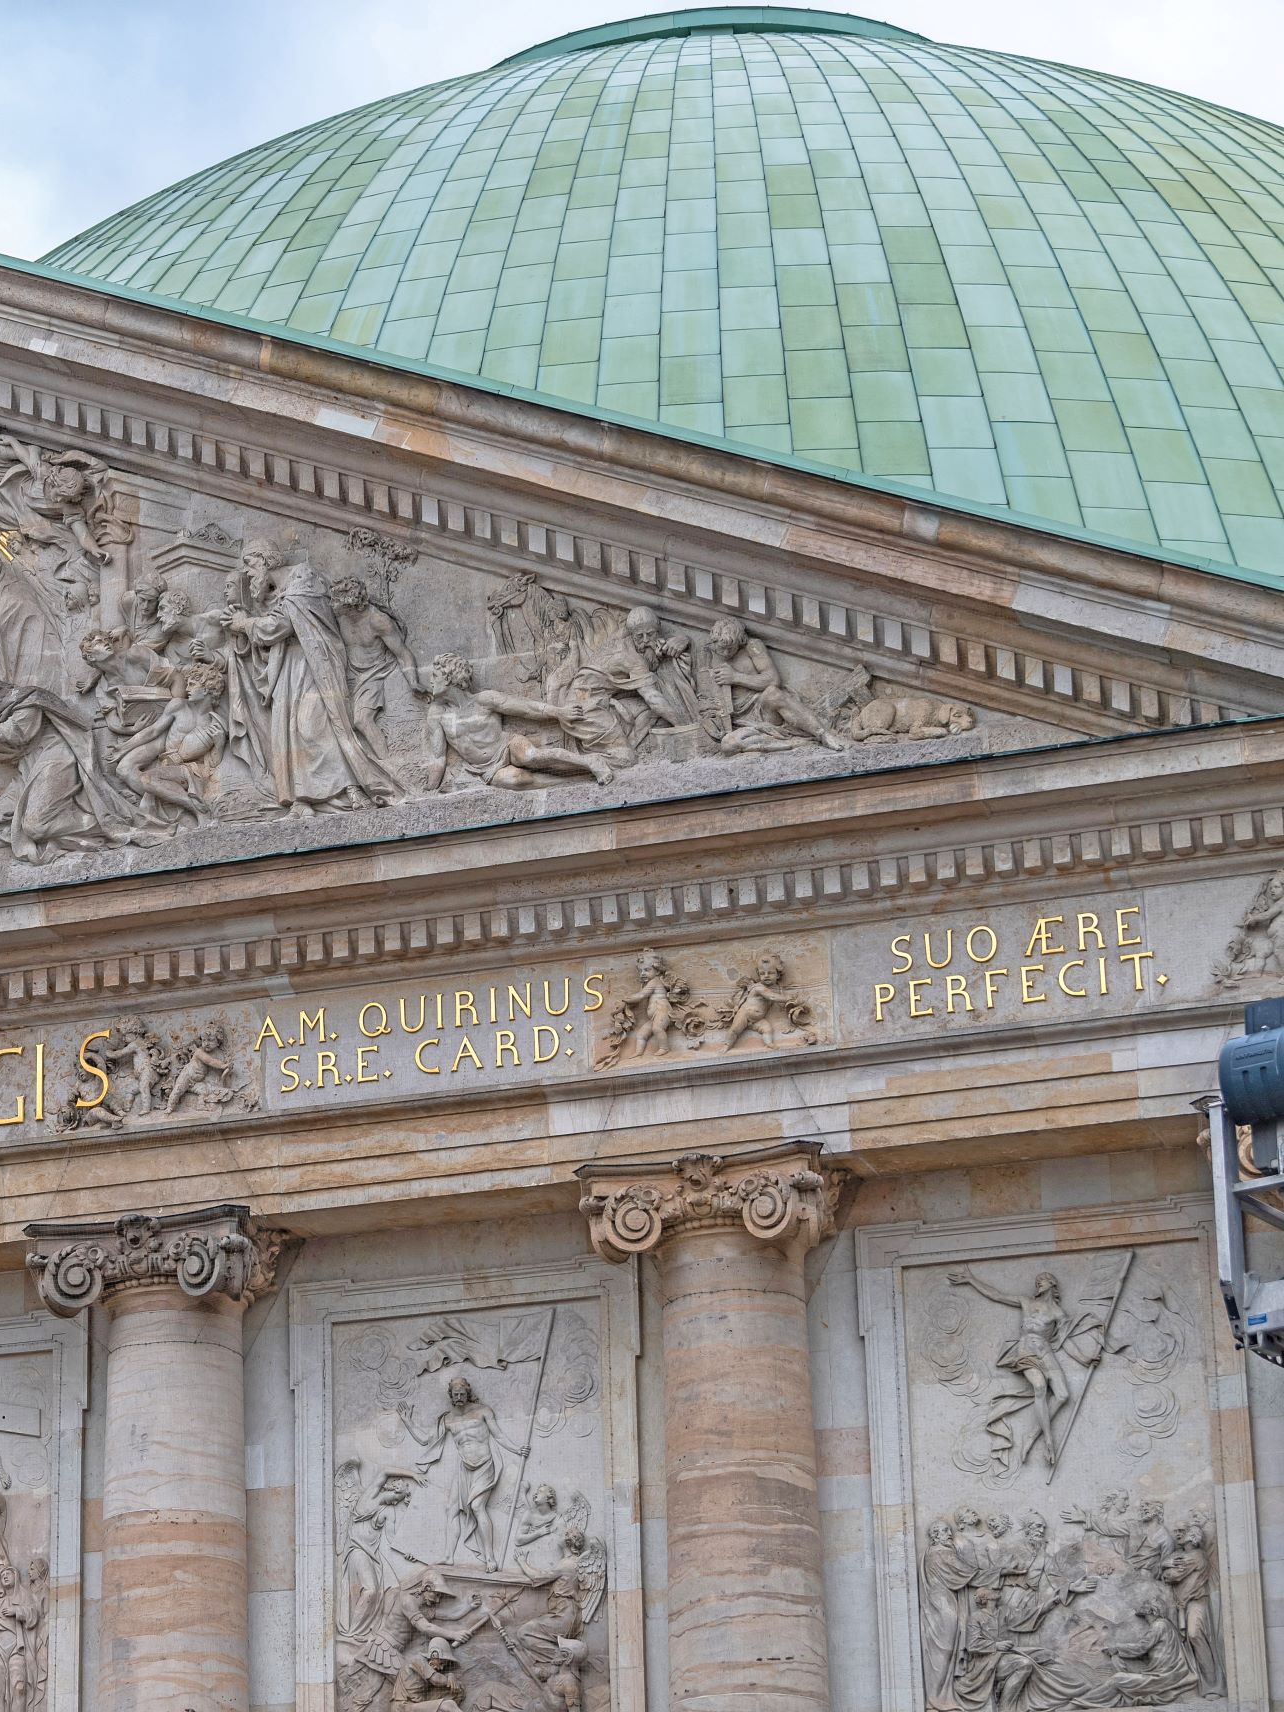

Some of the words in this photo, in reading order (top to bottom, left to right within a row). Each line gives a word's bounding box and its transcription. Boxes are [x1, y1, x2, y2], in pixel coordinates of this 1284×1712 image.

[890, 925, 998, 974] SUO
[1024, 906, 1142, 957] ÆRE
[253, 1007, 338, 1051] A.M.
[358, 974, 605, 1038] QUIRINUS
[874, 951, 1170, 1021] PERFECIT.
[280, 1045, 393, 1092] S.R.E.
[414, 1023, 575, 1074] CARD:
